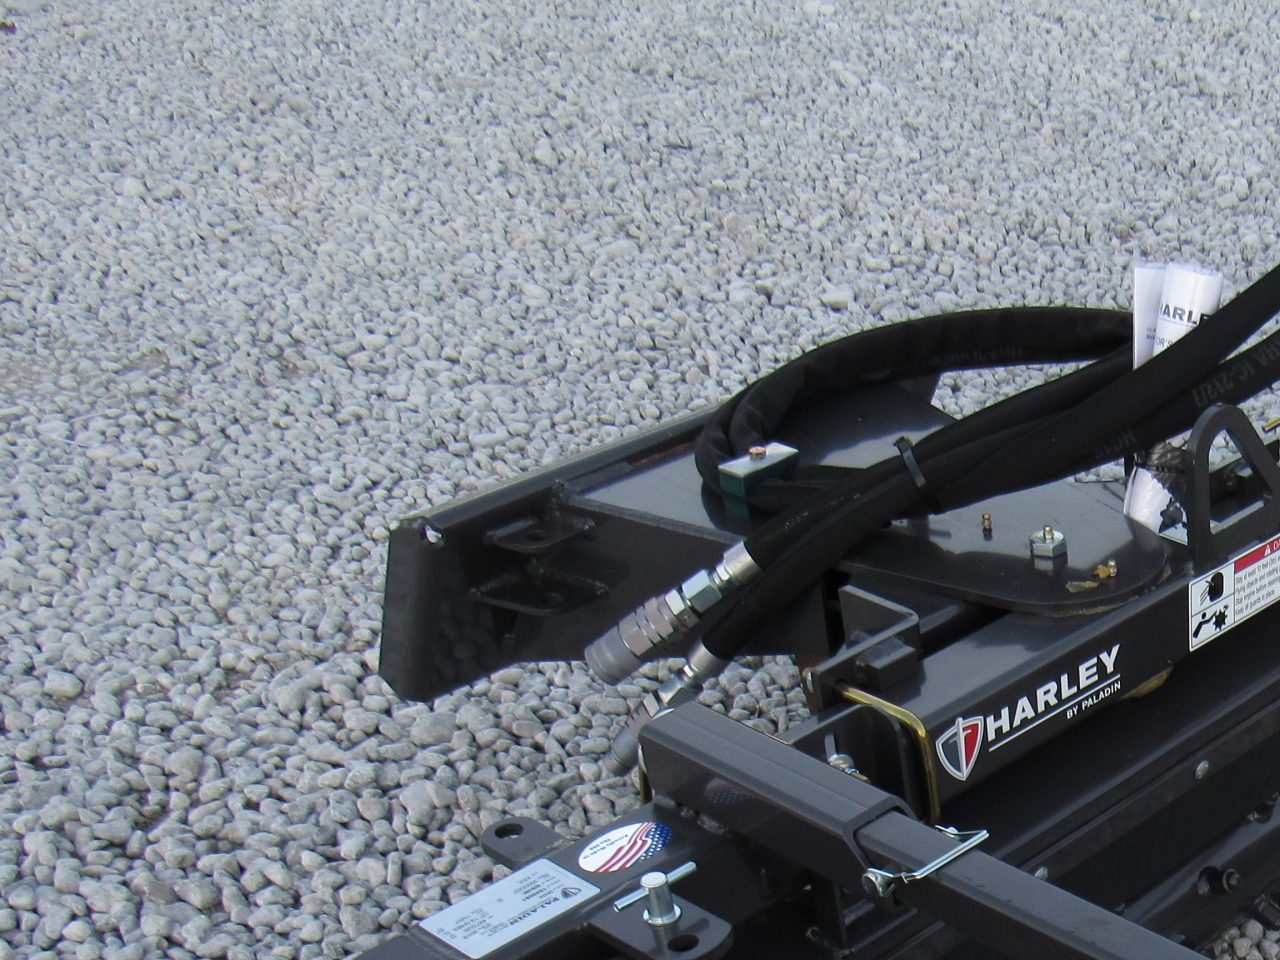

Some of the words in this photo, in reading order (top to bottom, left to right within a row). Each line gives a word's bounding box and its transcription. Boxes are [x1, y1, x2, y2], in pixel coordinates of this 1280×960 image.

[986, 643, 1121, 742] HARLEY
[1066, 705, 1079, 720] BY
[1081, 680, 1121, 711] PALADIN
[509, 896, 561, 927] PALADIN
